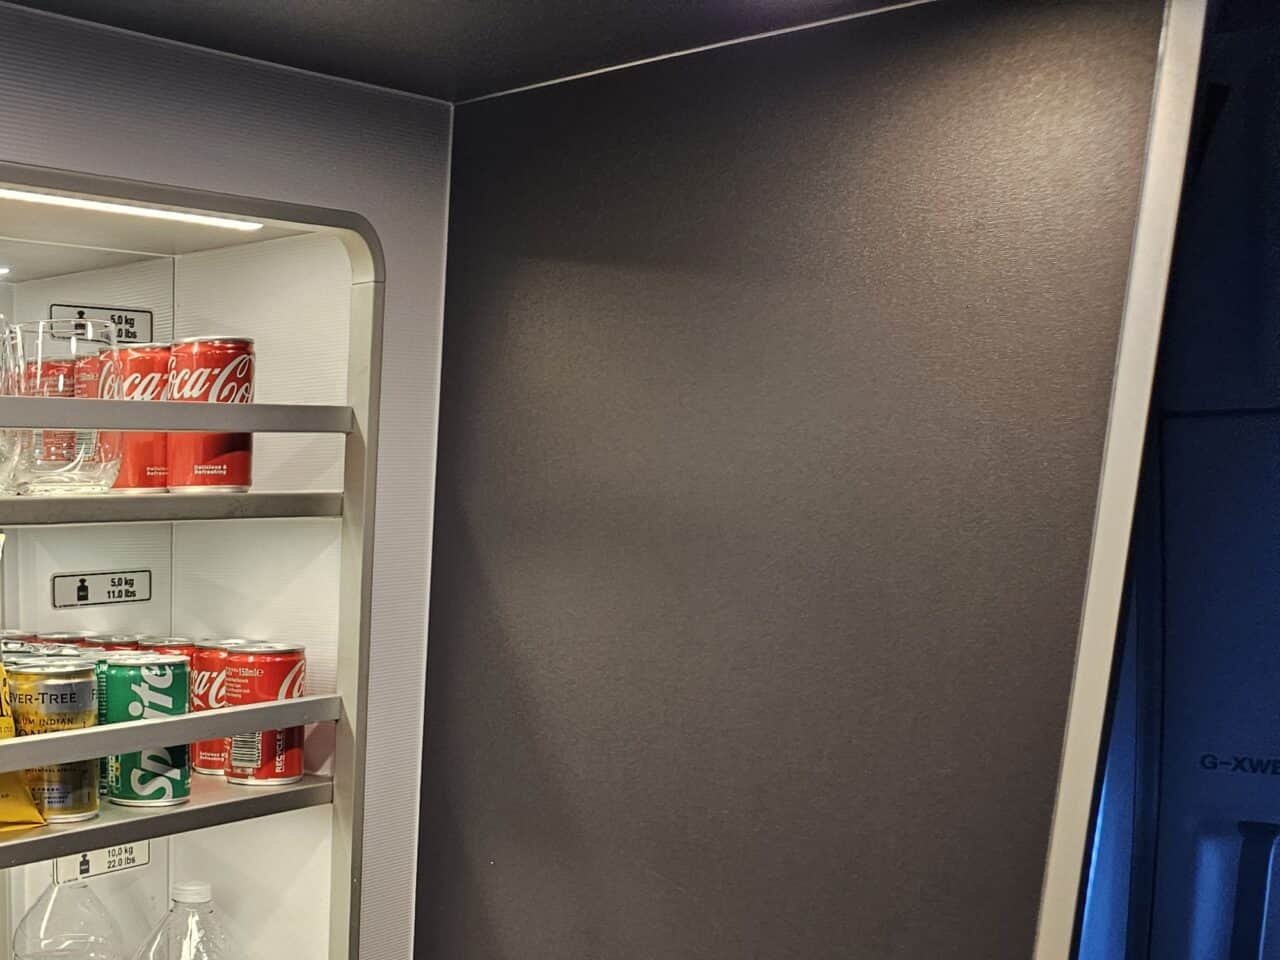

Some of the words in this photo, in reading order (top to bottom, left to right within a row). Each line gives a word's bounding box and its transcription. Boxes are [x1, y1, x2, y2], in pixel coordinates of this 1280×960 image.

[124, 315, 135, 329] kg
[125, 328, 137, 339] lbs
[124, 577, 135, 588] kg
[124, 589, 137, 598] lbs
[128, 664, 182, 801] Spite
[124, 846, 134, 856] kg
[124, 857, 136, 865] lbs
